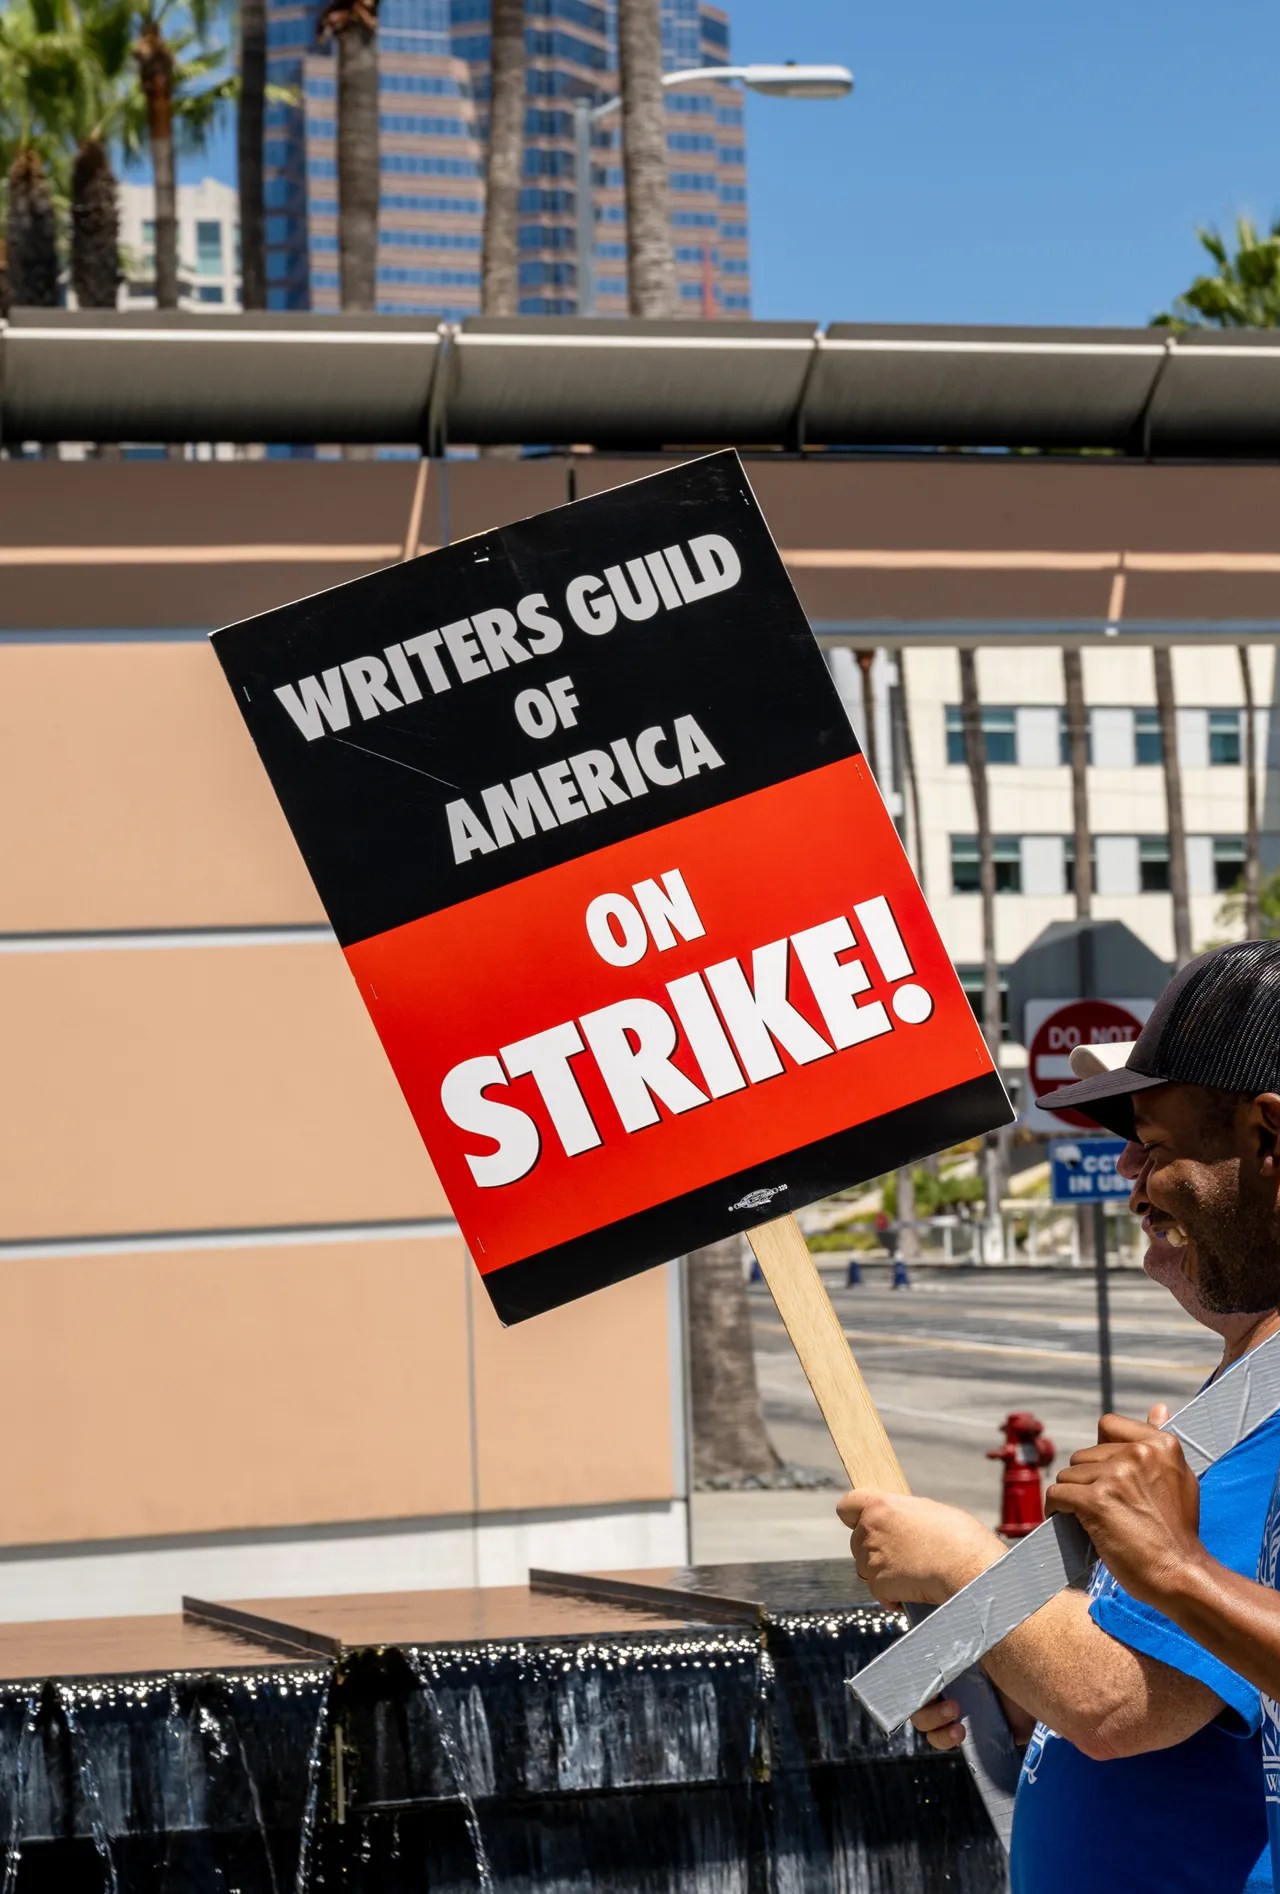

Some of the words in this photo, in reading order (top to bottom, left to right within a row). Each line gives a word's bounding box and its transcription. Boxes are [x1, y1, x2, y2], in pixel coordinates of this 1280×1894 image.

[273, 593, 564, 742] WRITERS
[565, 533, 743, 636] GUILD
[514, 675, 580, 739] OF
[445, 714, 726, 865] AMERICA
[585, 868, 706, 967] ON
[439, 895, 935, 1190] STRIKE!
[1049, 1026, 1082, 1049] DO
[1090, 1025, 1136, 1044] NOT
[1068, 1175, 1093, 1194] IN
